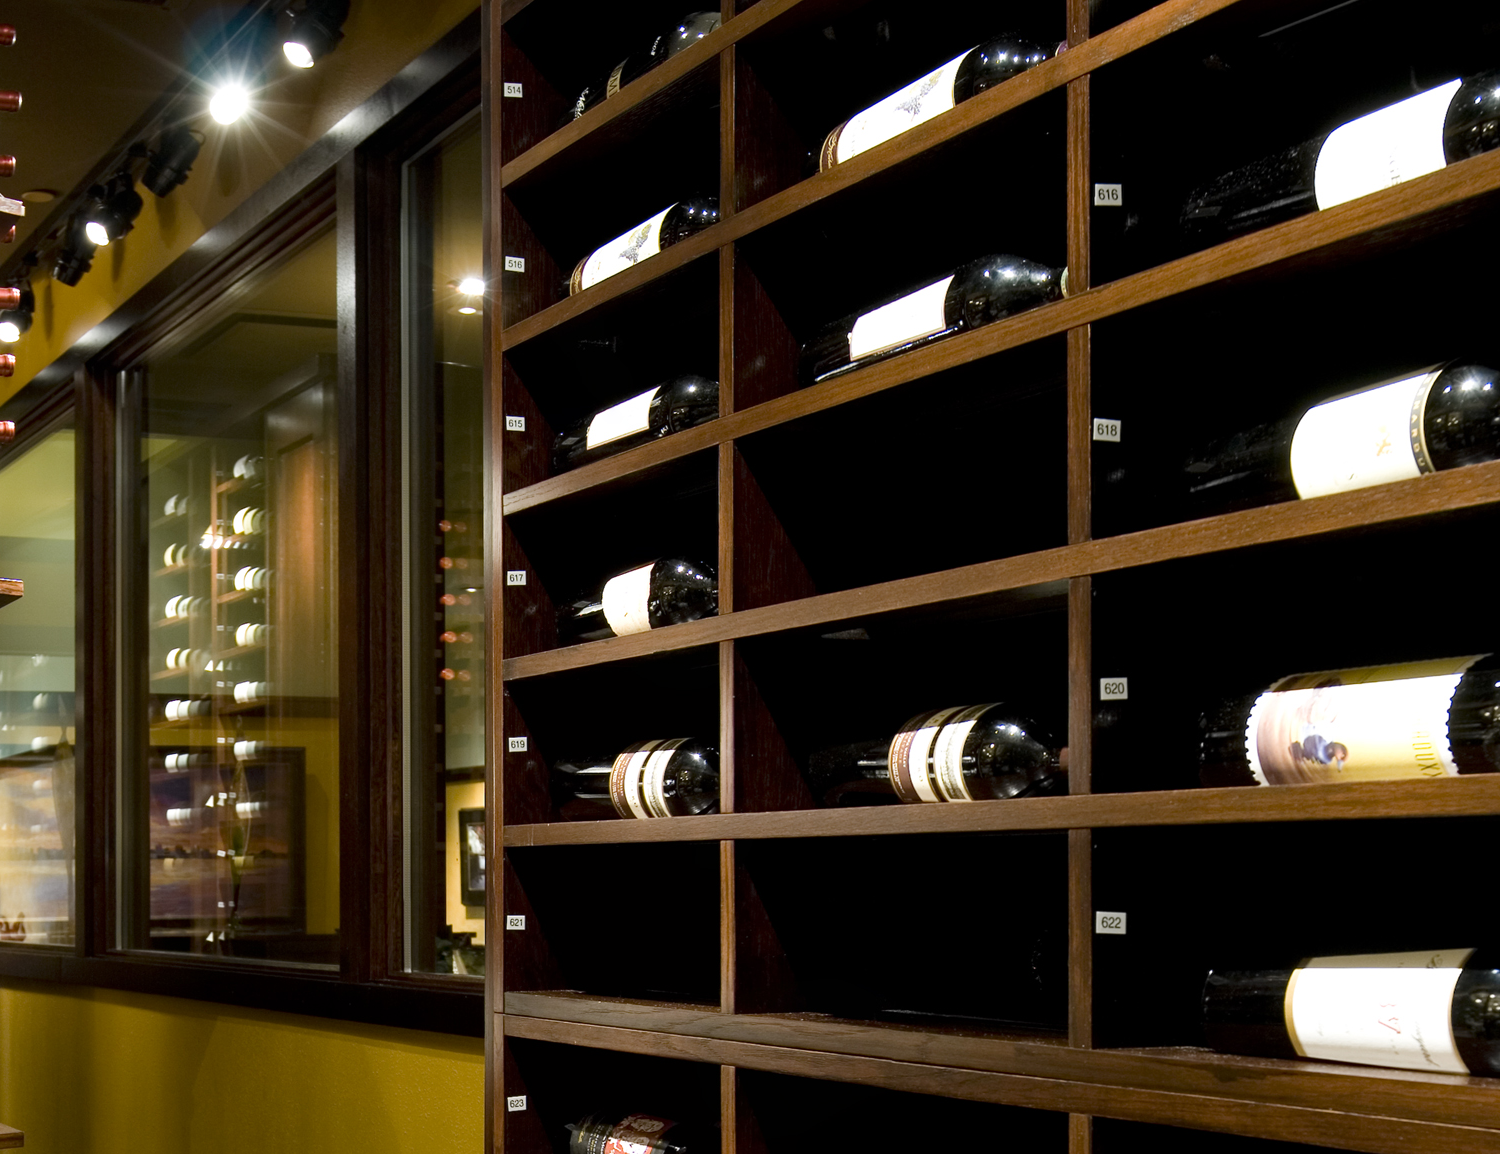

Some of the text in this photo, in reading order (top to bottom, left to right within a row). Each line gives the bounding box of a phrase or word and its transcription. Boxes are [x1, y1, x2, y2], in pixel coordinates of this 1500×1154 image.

[507, 85, 521, 94] 514
[1097, 188, 1119, 201] 616
[508, 259, 523, 269] 516
[508, 419, 523, 428] 615
[1096, 423, 1118, 438] 618
[509, 573, 524, 583] 617
[1104, 682, 1125, 695] 620
[510, 739, 526, 749] 619
[509, 918, 523, 927] 621
[1101, 916, 1122, 929] 622
[509, 1098, 525, 1109] 623
